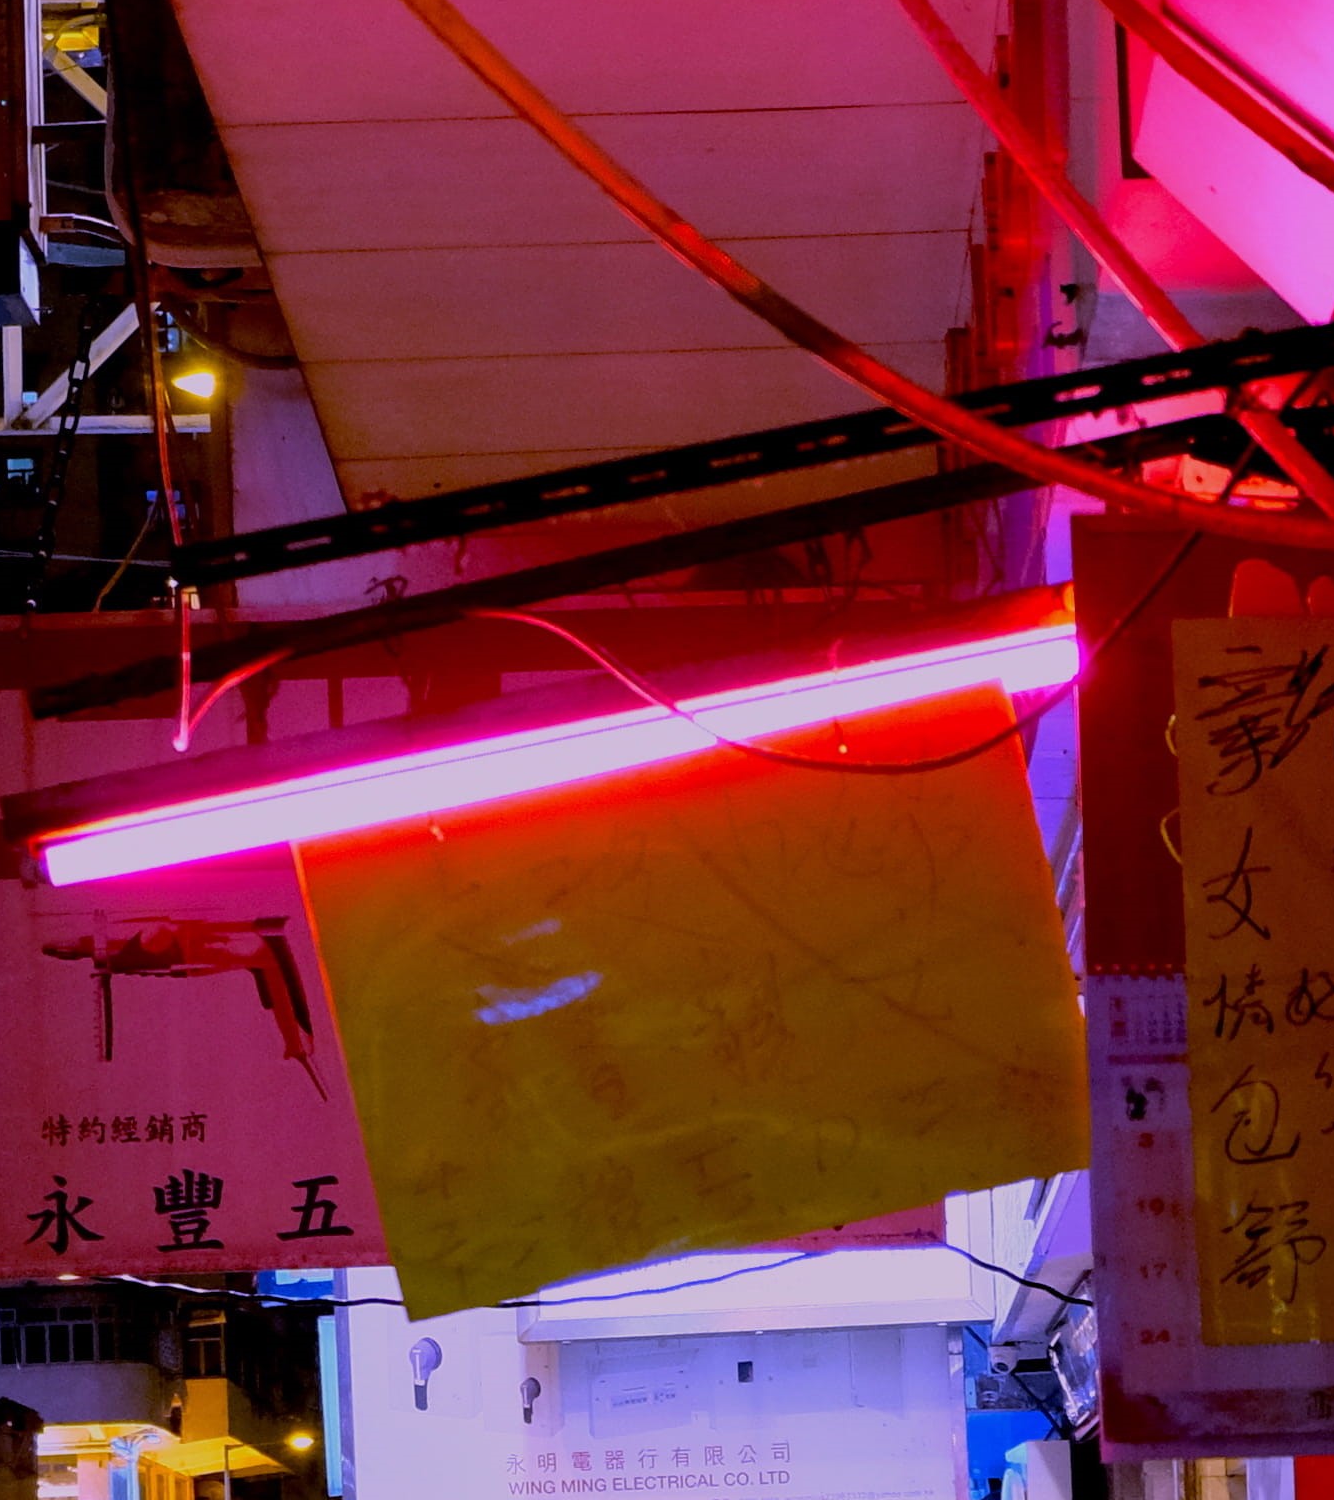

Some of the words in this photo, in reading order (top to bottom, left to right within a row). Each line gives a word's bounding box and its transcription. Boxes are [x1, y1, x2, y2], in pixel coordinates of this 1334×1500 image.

[41, 1111, 208, 1147] 特約經銷商
[506, 1441, 791, 1475] 永明電器行有限公司
[508, 1480, 556, 1496] WING
[561, 1478, 607, 1494] MING
[612, 1474, 718, 1491] ELECTRICAL
[723, 1471, 755, 1488] CO.
[758, 1470, 791, 1486] LTD
